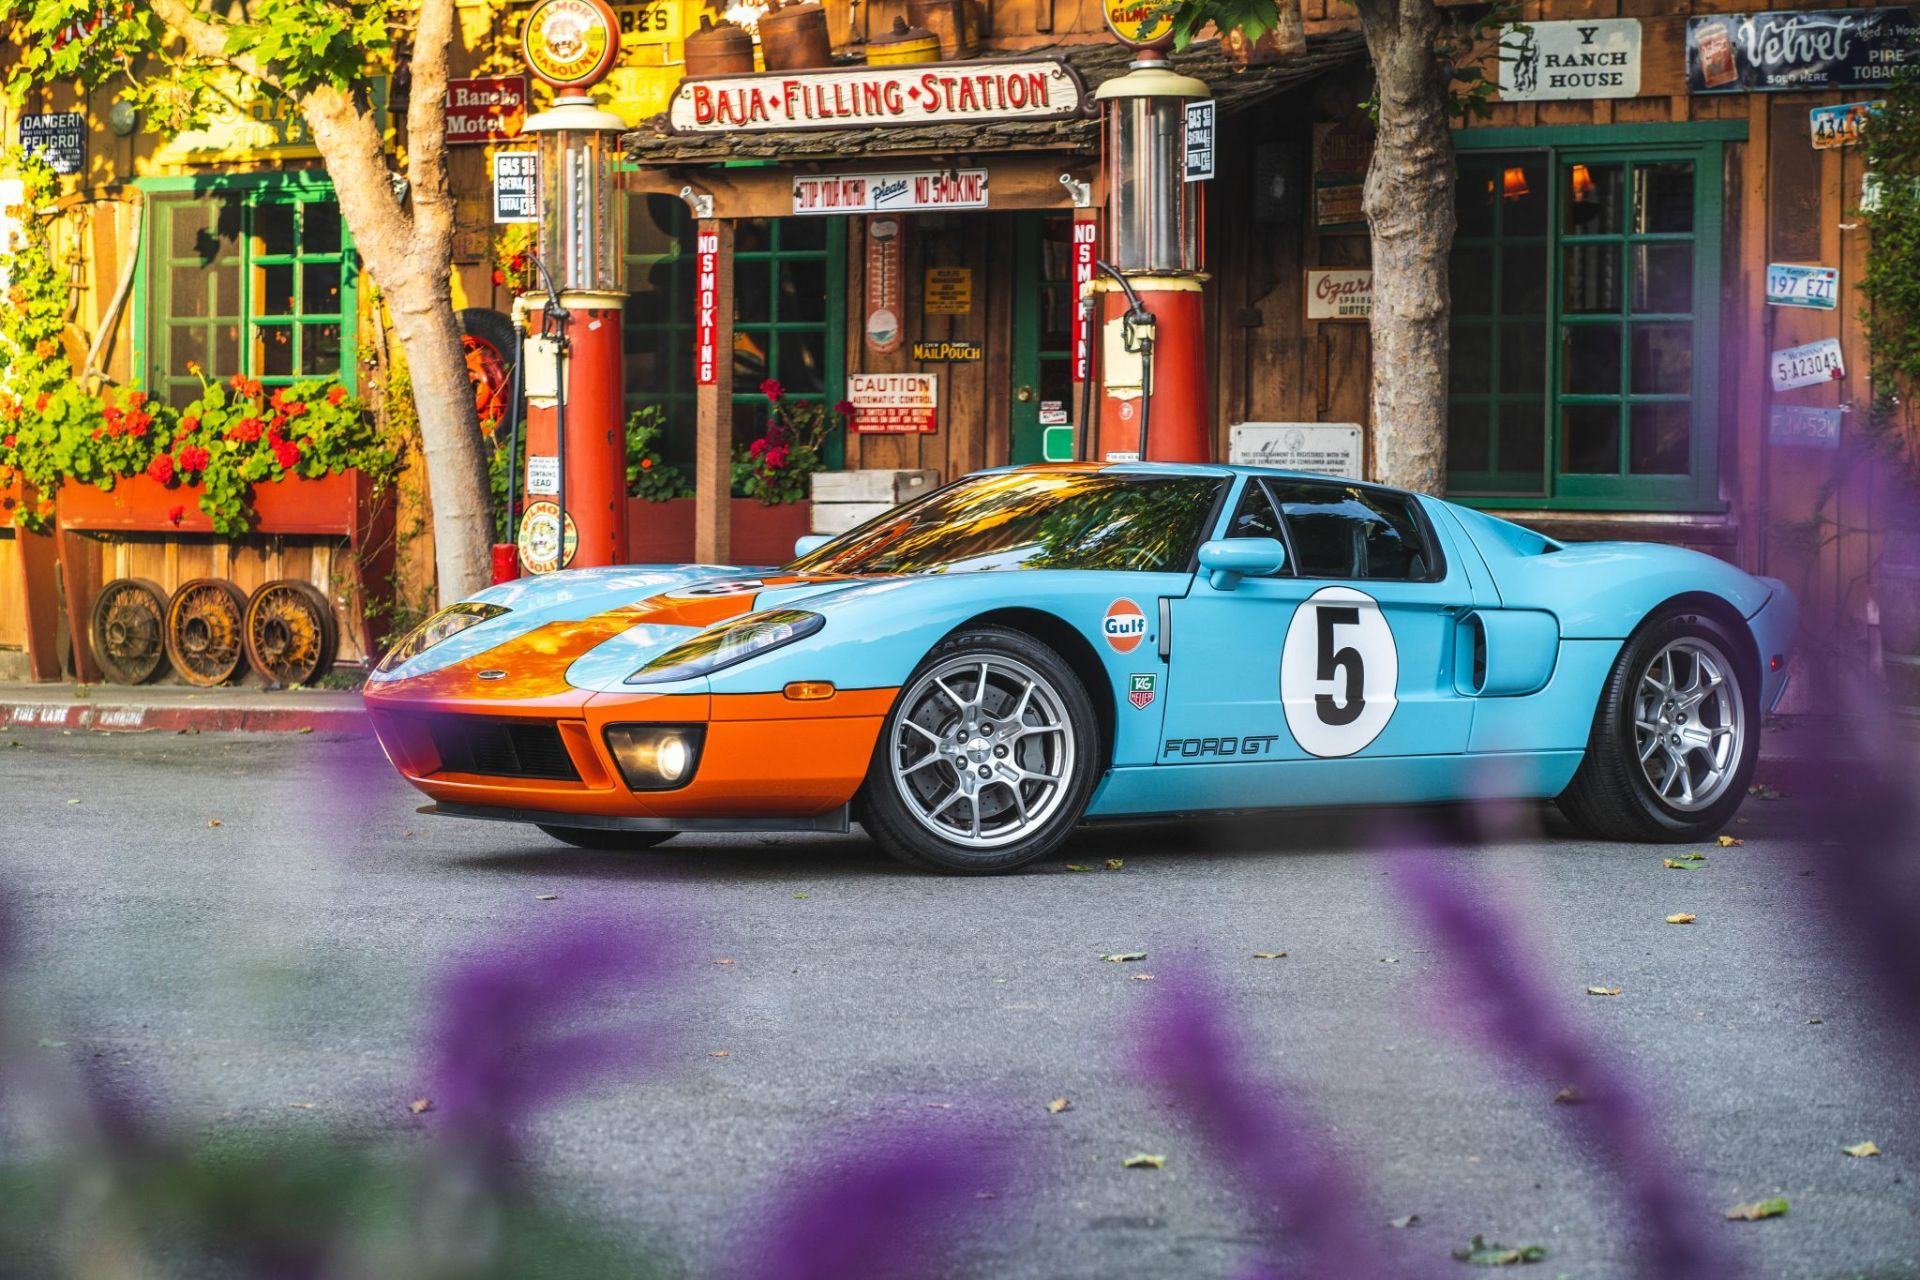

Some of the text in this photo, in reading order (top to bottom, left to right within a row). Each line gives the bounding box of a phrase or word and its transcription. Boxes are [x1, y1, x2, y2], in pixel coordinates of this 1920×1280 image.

[1577, 26, 1599, 45] Y
[1737, 16, 1855, 67] Velvet
[534, 48, 600, 76] GASOLINE
[1545, 52, 1628, 68] RANCH
[1549, 72, 1623, 88] HOUSE
[1800, 72, 1829, 83] HERE
[456, 87, 520, 107] Rancho
[693, 72, 1050, 126] BAJA FILLING STATION
[24, 113, 80, 130] DANGER!
[446, 112, 506, 134] Motel
[23, 134, 79, 151] PELIGRO!
[914, 176, 929, 204] NO
[932, 173, 983, 204] SMOKING
[1074, 224, 1096, 243] NO
[697, 235, 719, 254] NO
[1771, 275, 1833, 299] 197 EZT
[701, 254, 715, 382] SMOKING
[854, 377, 930, 392] CAUTION
[853, 395, 933, 404] AUTOMATIC CONTROL
[523, 503, 573, 532] GILMOE
[1104, 618, 1145, 634] Gulf
[1314, 605, 1366, 726] 5
[1134, 677, 1152, 690] TAG
[1130, 692, 1153, 706] HEUER
[1163, 735, 1279, 758] FORD GT
